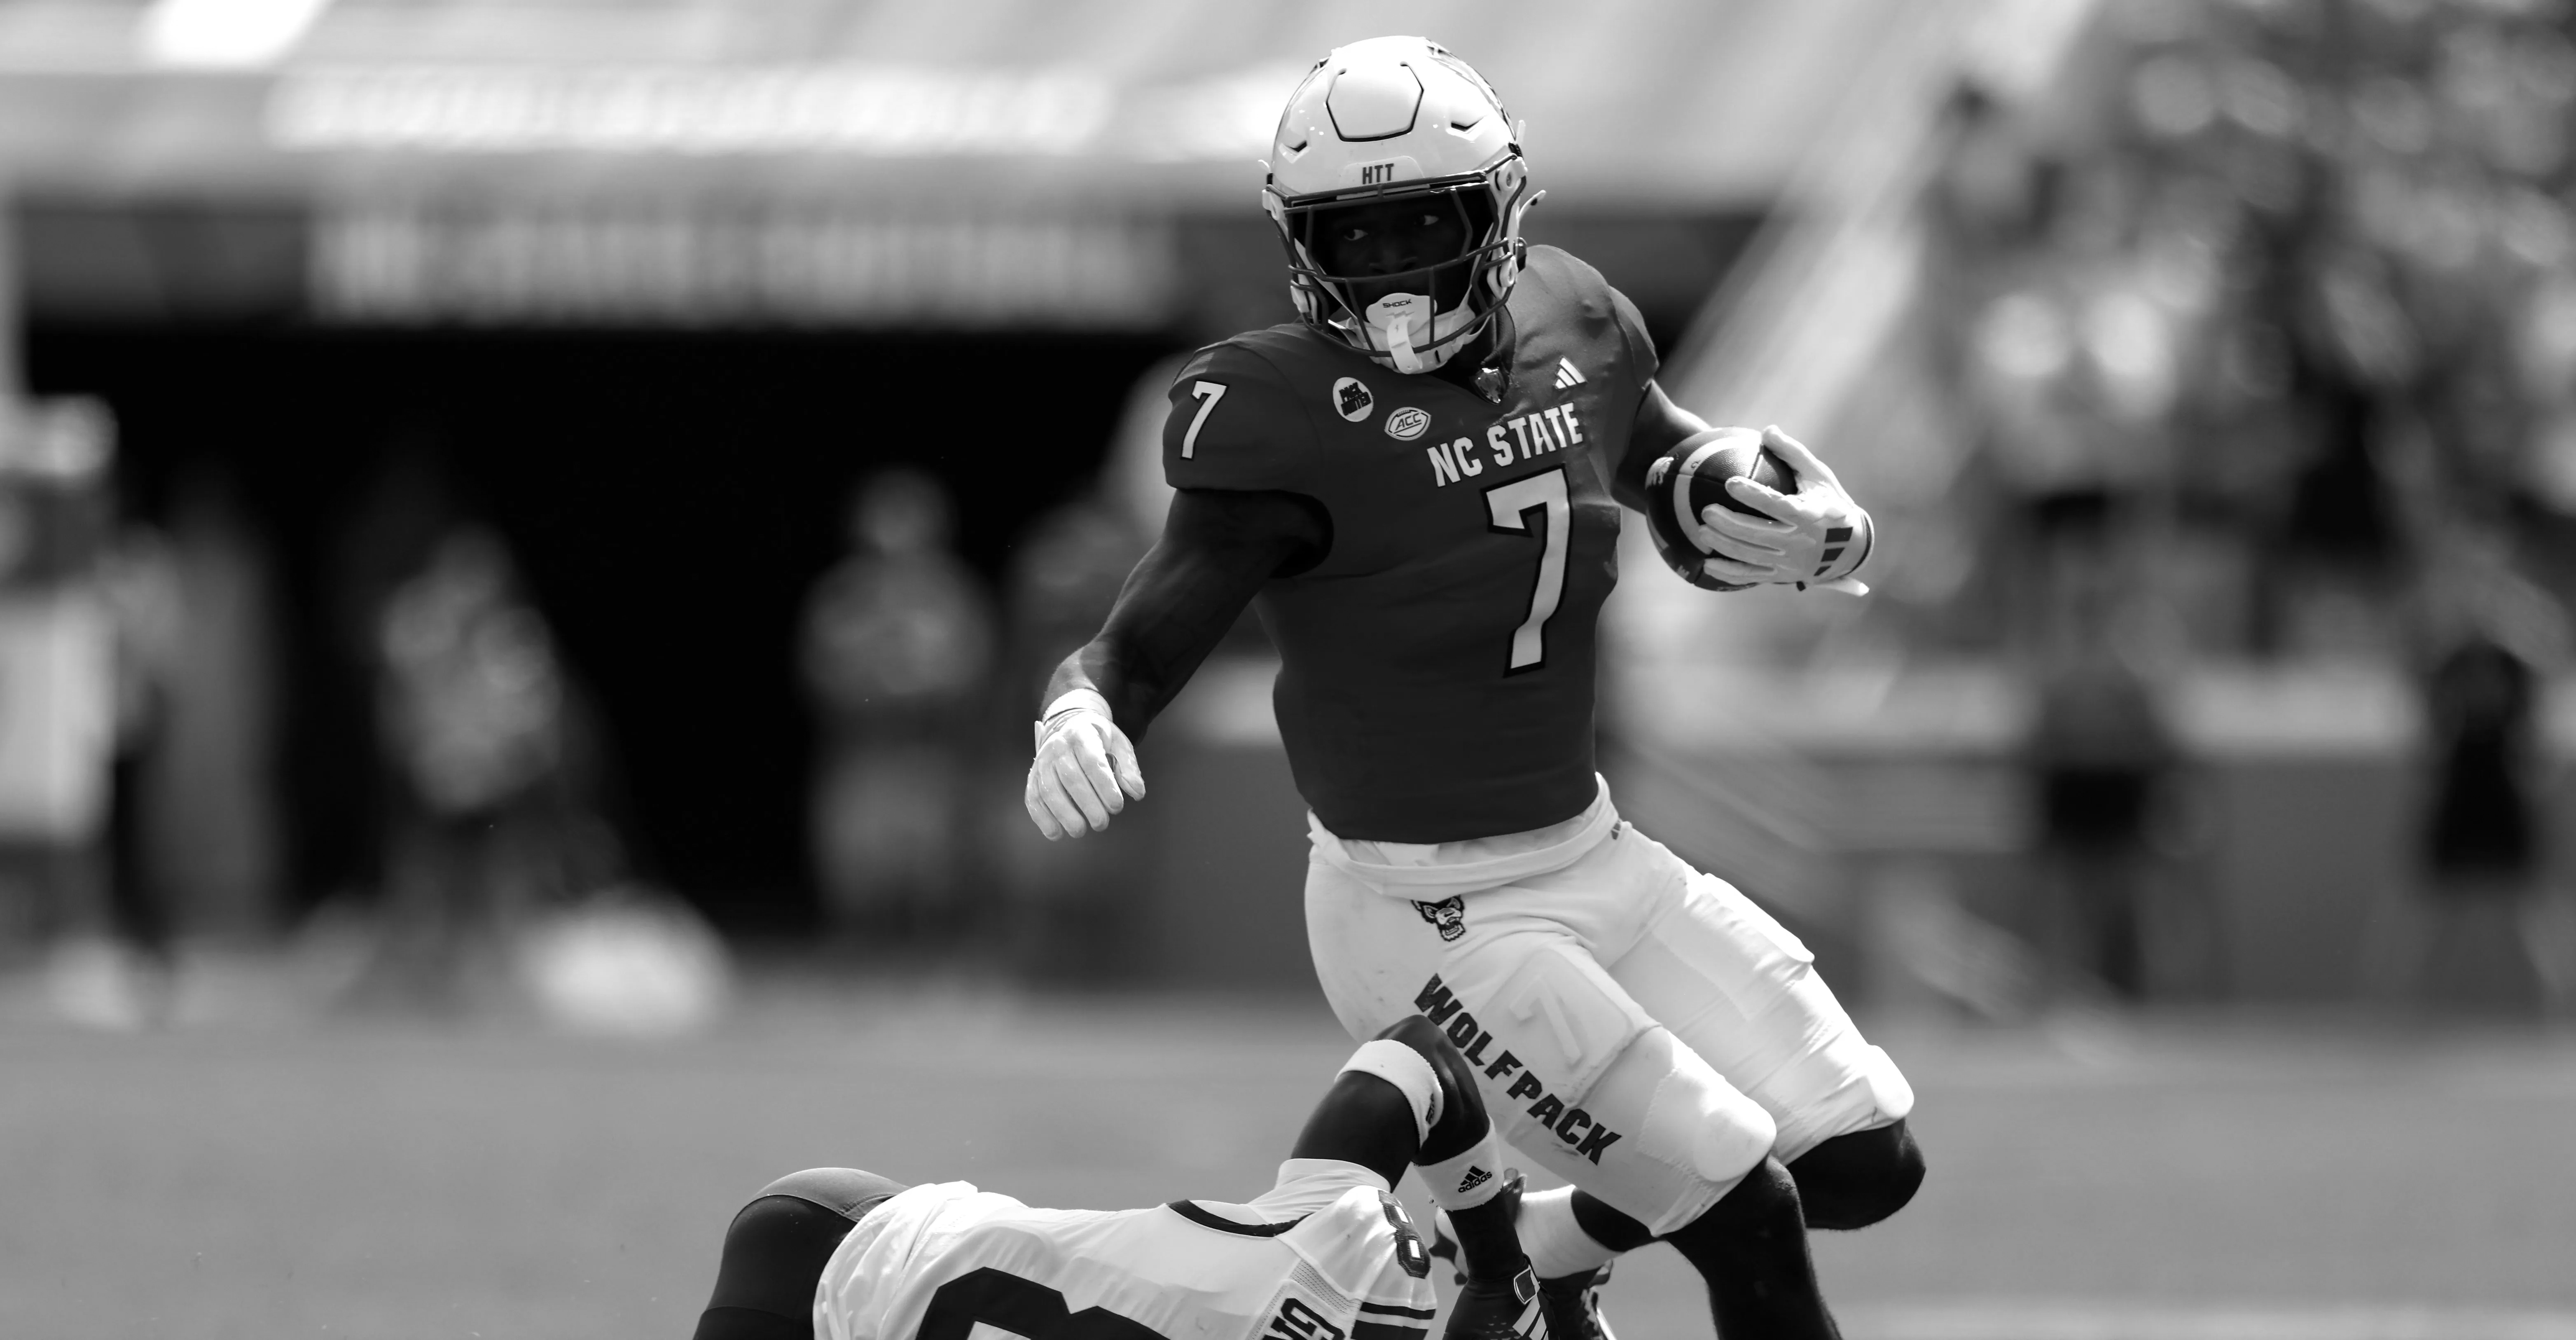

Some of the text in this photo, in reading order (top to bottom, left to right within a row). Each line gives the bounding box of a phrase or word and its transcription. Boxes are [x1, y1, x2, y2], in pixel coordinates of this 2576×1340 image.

[1362, 163, 1394, 184] HTT
[1382, 299, 1412, 308] SHOCK
[1181, 380, 1228, 459] 7
[1395, 413, 1422, 431] ACC
[1427, 401, 1583, 487] NC STATE
[1484, 465, 1572, 673] 7
[1414, 973, 1622, 1166] WOLFPACK
[1458, 1172, 1492, 1193] adidas
